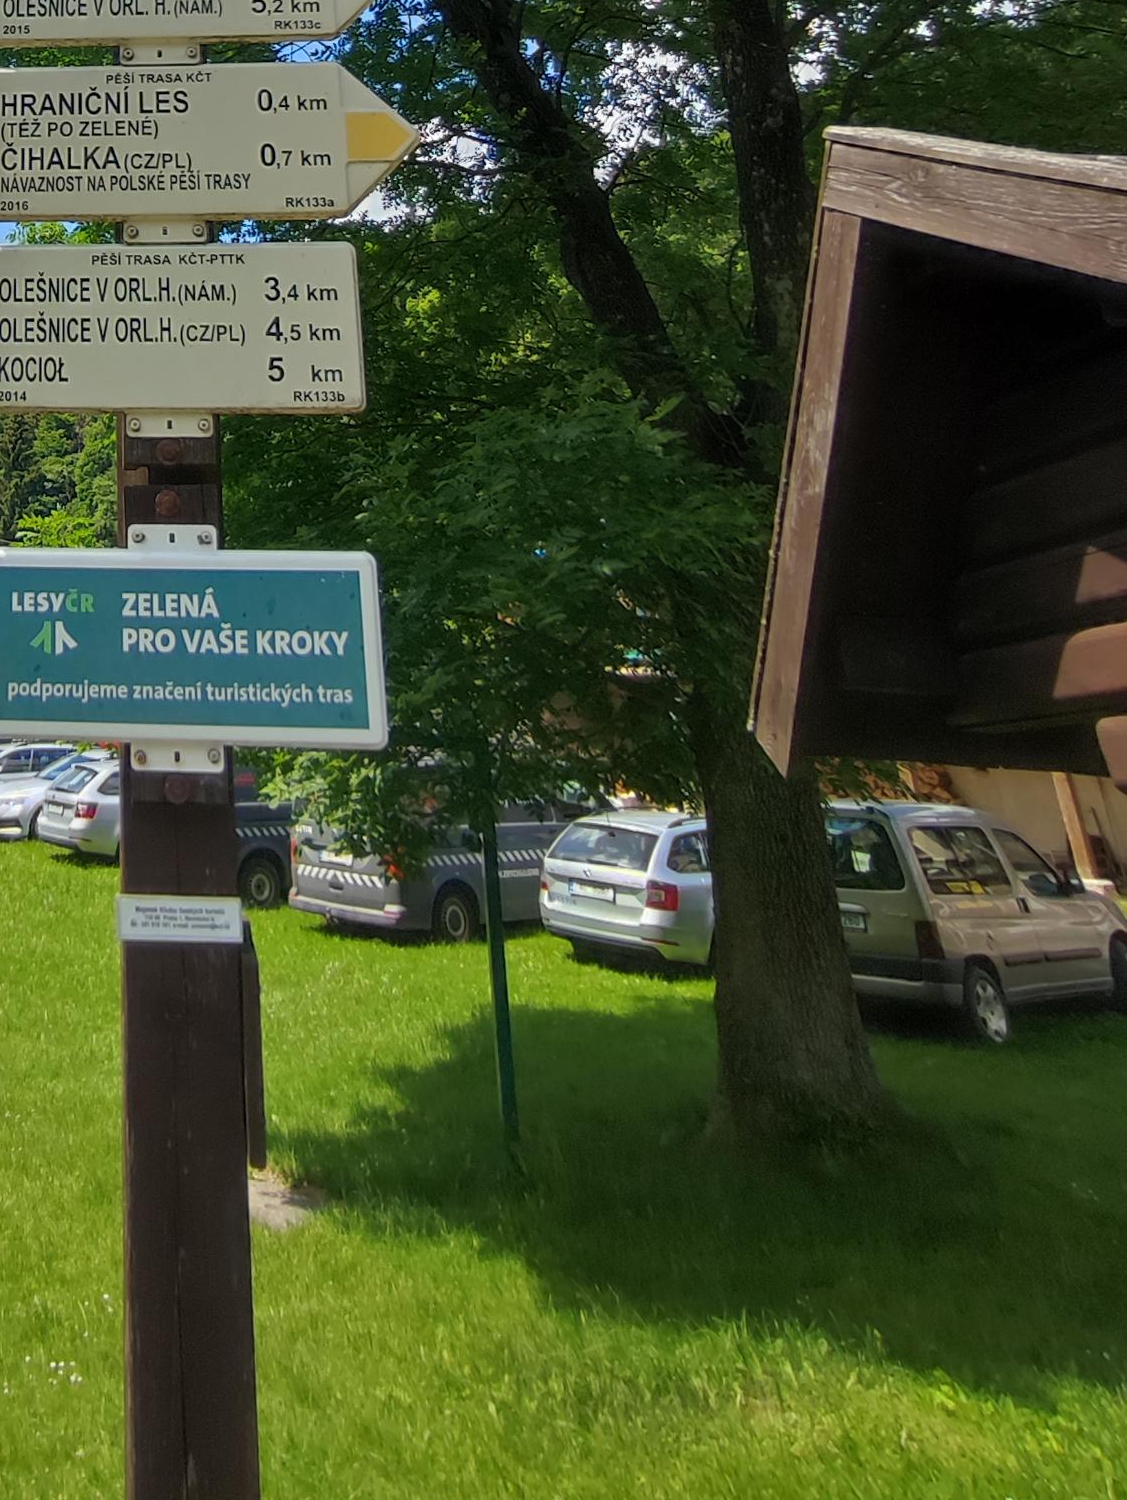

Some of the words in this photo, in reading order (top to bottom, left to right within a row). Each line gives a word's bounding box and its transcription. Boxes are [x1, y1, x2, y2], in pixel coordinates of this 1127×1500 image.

[2, 24, 31, 35] 2015
[274, 19, 322, 30] RK133c
[105, 71, 135, 85] PĚŠÍ
[138, 73, 183, 84] TRASA
[185, 70, 213, 83] KČT
[1, 85, 129, 117] HRANIČNÍ
[138, 90, 189, 114] LES
[257, 88, 291, 114] 0,4
[296, 94, 328, 111] km
[0, 118, 42, 142] (TÉŽ
[47, 121, 74, 138] PO
[78, 119, 159, 140] ZELENÉ)
[0, 141, 121, 171] ČIHALKA
[124, 152, 194, 173] (CZ/PL)
[260, 143, 293, 170] 0,7
[300, 149, 332, 167] km
[0, 172, 84, 194] NÁVAZNOST
[87, 175, 107, 192] NA
[109, 174, 166, 192] POLSKÉ
[169, 169, 201, 191] PĚŠÍ
[203, 173, 251, 190] TRASY
[0, 200, 29, 212] 2016
[285, 196, 335, 208] RK133a
[91, 252, 122, 266] PĚŠÍ
[125, 254, 172, 266] TRASA
[178, 252, 245, 265] KČT-PTTK
[96, 277, 109, 303] V
[178, 283, 237, 306] (NÁM.)
[264, 276, 300, 303] 3,4
[306, 283, 339, 302] km
[96, 317, 110, 343] V
[179, 323, 246, 346] (CZ/PL)
[265, 316, 302, 344] 4,5
[308, 323, 341, 341] km
[267, 356, 285, 382] 5
[310, 364, 343, 383] km
[293, 390, 346, 403] RK133b
[121, 586, 220, 619] ZELENÁ
[122, 627, 176, 653] PRO
[181, 622, 249, 655] VAŠE
[256, 630, 349, 656] KROKY
[7, 677, 129, 702] podporujeme
[132, 681, 202, 701] značení
[205, 682, 314, 708] turistických
[316, 684, 354, 704] tras
